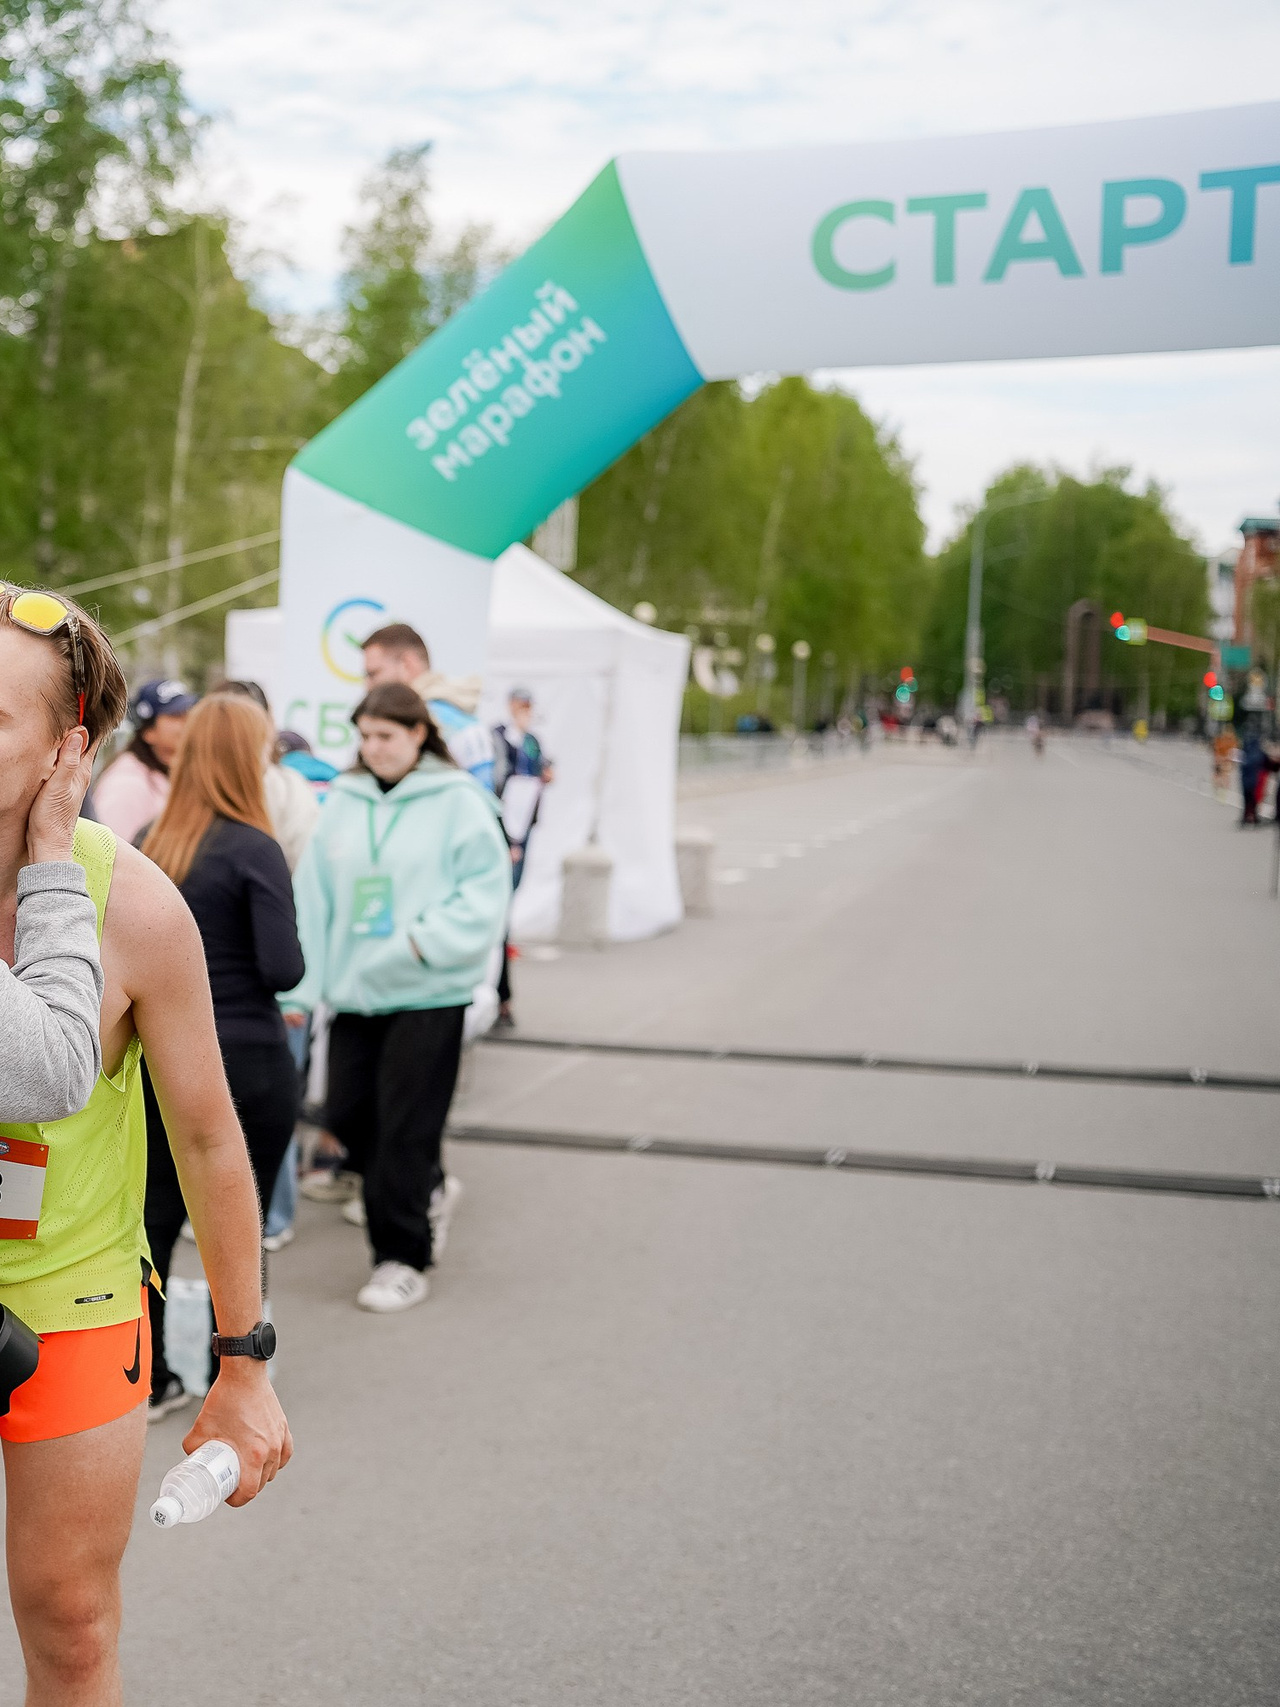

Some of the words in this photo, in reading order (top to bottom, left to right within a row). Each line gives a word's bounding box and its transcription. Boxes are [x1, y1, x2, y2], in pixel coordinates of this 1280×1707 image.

[810, 164, 1280, 293] СТАРТ
[406, 280, 578, 451] зелёный
[431, 316, 607, 482] марафон
[283, 699, 352, 749] СБ
